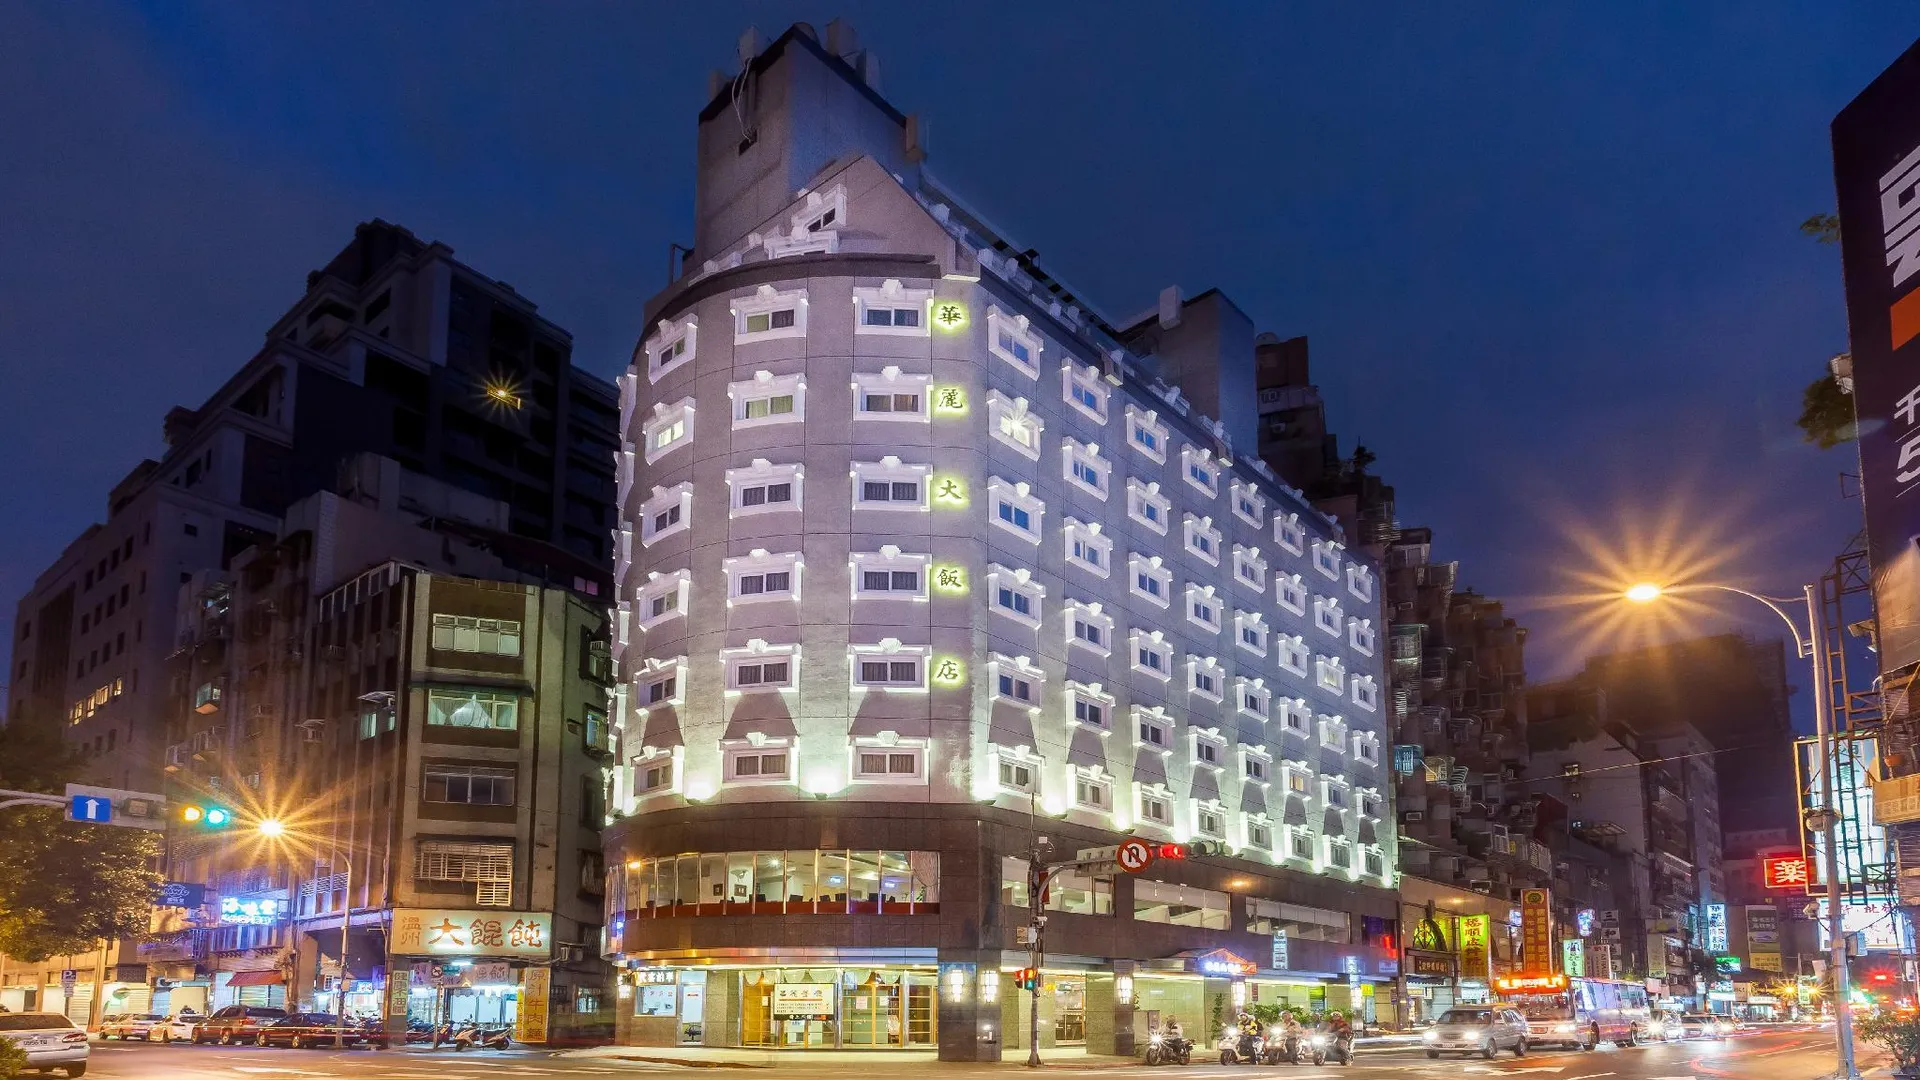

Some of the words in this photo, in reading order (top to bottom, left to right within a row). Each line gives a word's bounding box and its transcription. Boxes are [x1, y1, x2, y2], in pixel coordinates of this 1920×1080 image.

[938, 305, 963, 680] 華麗大飯店
[428, 917, 543, 948] 大餛飩
[526, 969, 547, 1040] 原汁牛肉麵
